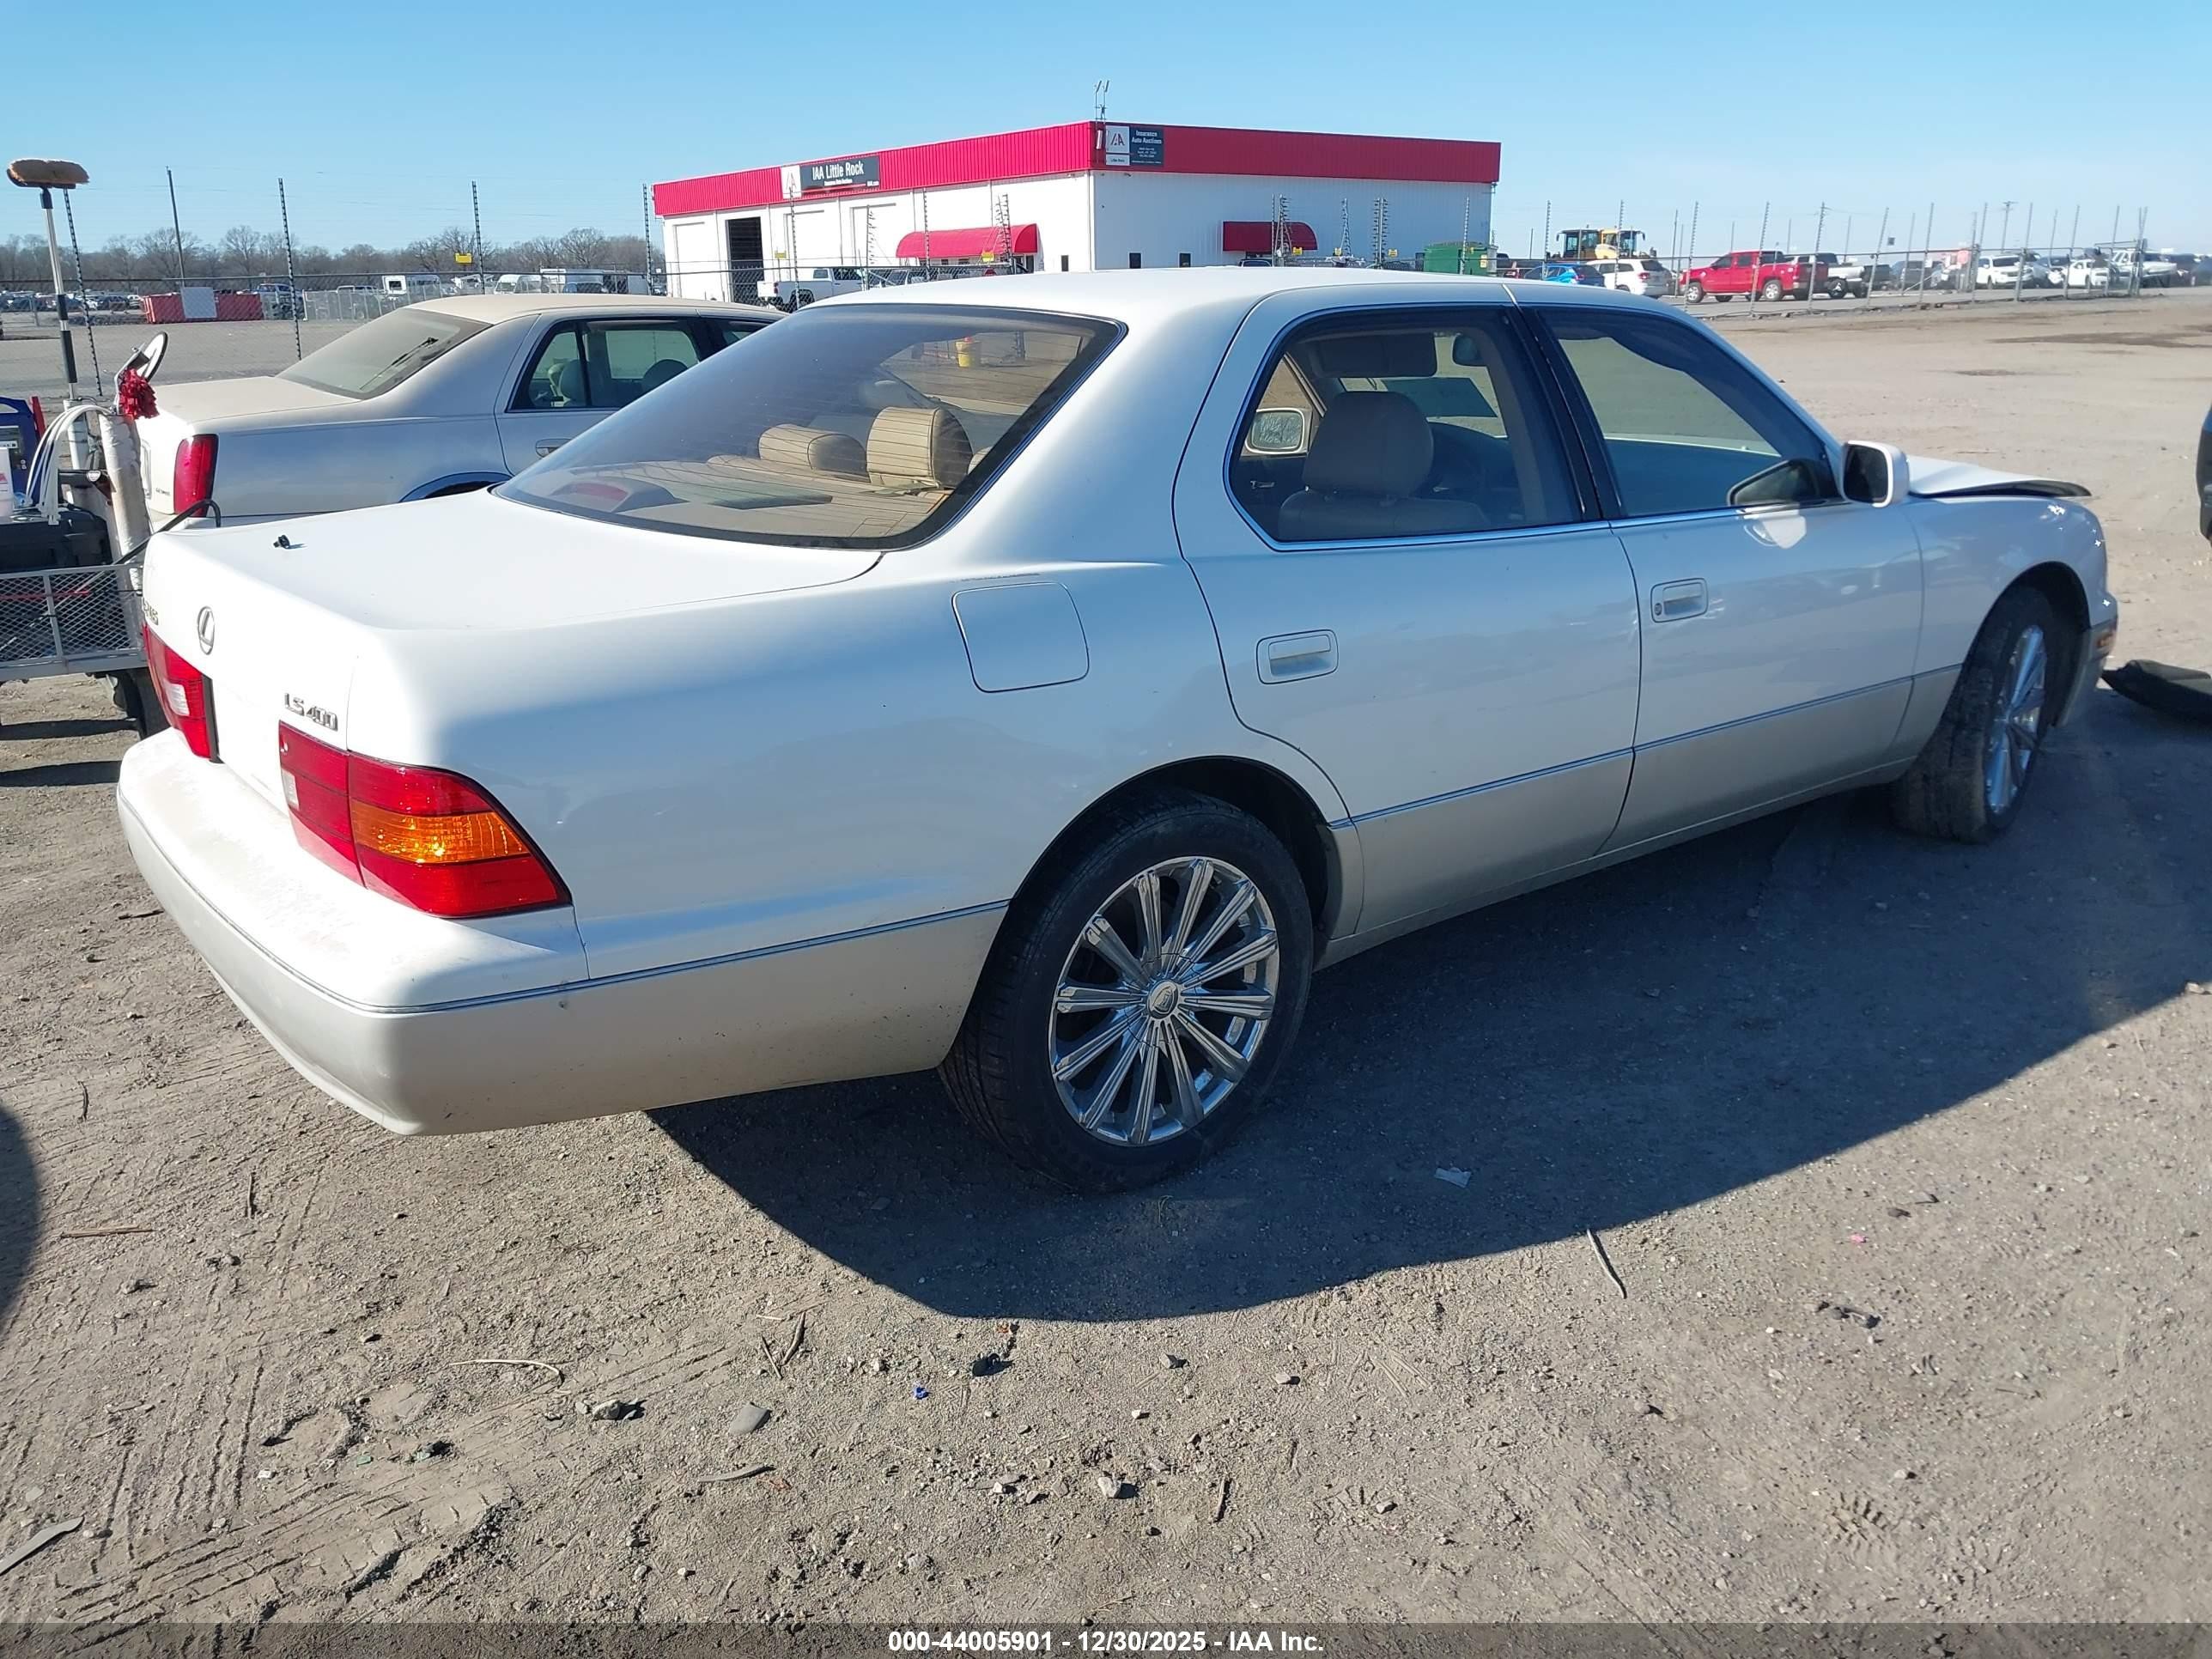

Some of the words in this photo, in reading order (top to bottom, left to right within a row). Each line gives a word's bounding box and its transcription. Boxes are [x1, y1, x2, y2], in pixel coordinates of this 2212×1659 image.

[812, 167, 824, 180] IAA
[826, 163, 844, 179] Little
[846, 161, 864, 176] Rock
[284, 693, 305, 716] LS
[306, 706, 338, 732] 400
